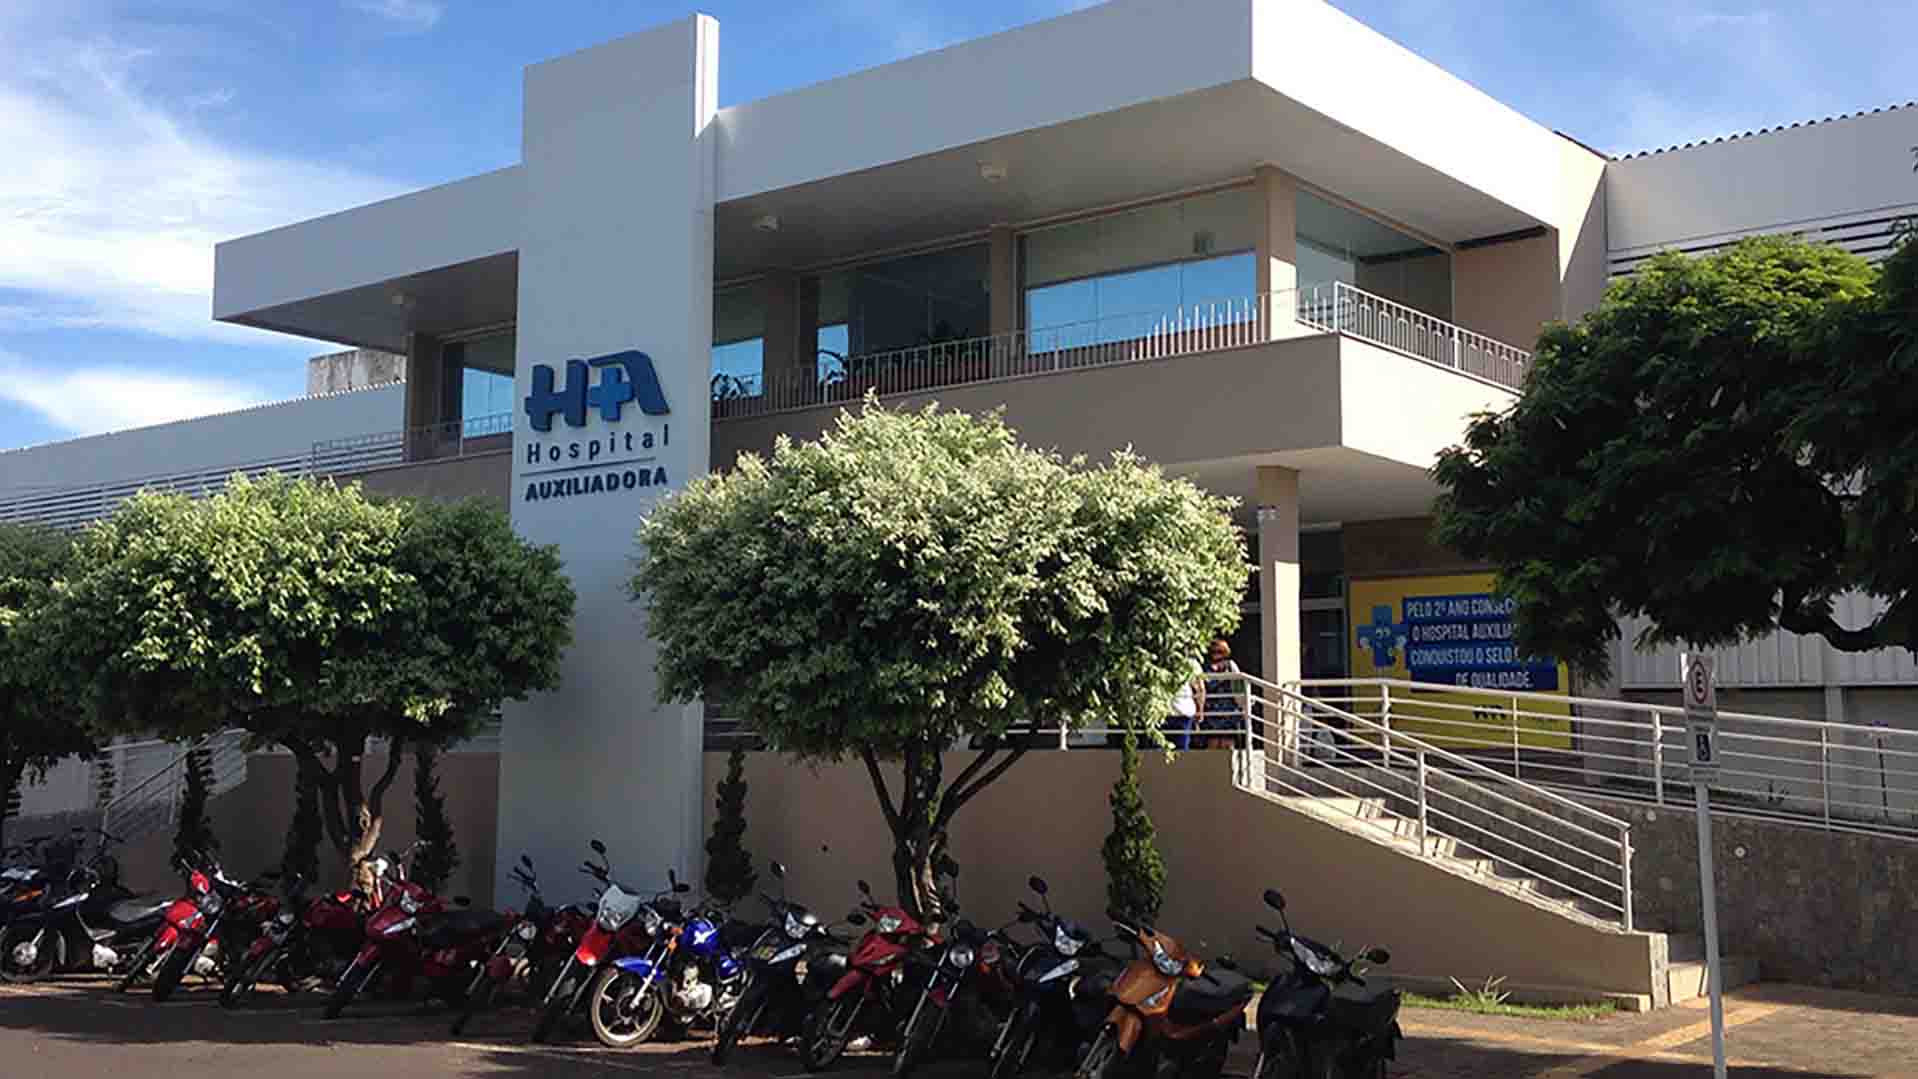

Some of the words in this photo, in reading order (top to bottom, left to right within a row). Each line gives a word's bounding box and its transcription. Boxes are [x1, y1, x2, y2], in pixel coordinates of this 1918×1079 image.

[527, 424, 668, 464] Hospital
[525, 467, 667, 501] AUXILIADORA
[1407, 601, 1432, 617] PELO
[1447, 599, 1469, 616] ANO
[1411, 625, 1421, 641] O
[1422, 624, 1470, 641] HOSPITAL
[1410, 648, 1474, 665] CONQUISTOU
[1475, 648, 1485, 664] O
[1486, 647, 1513, 664] SELO
[1456, 672, 1469, 687] DE
